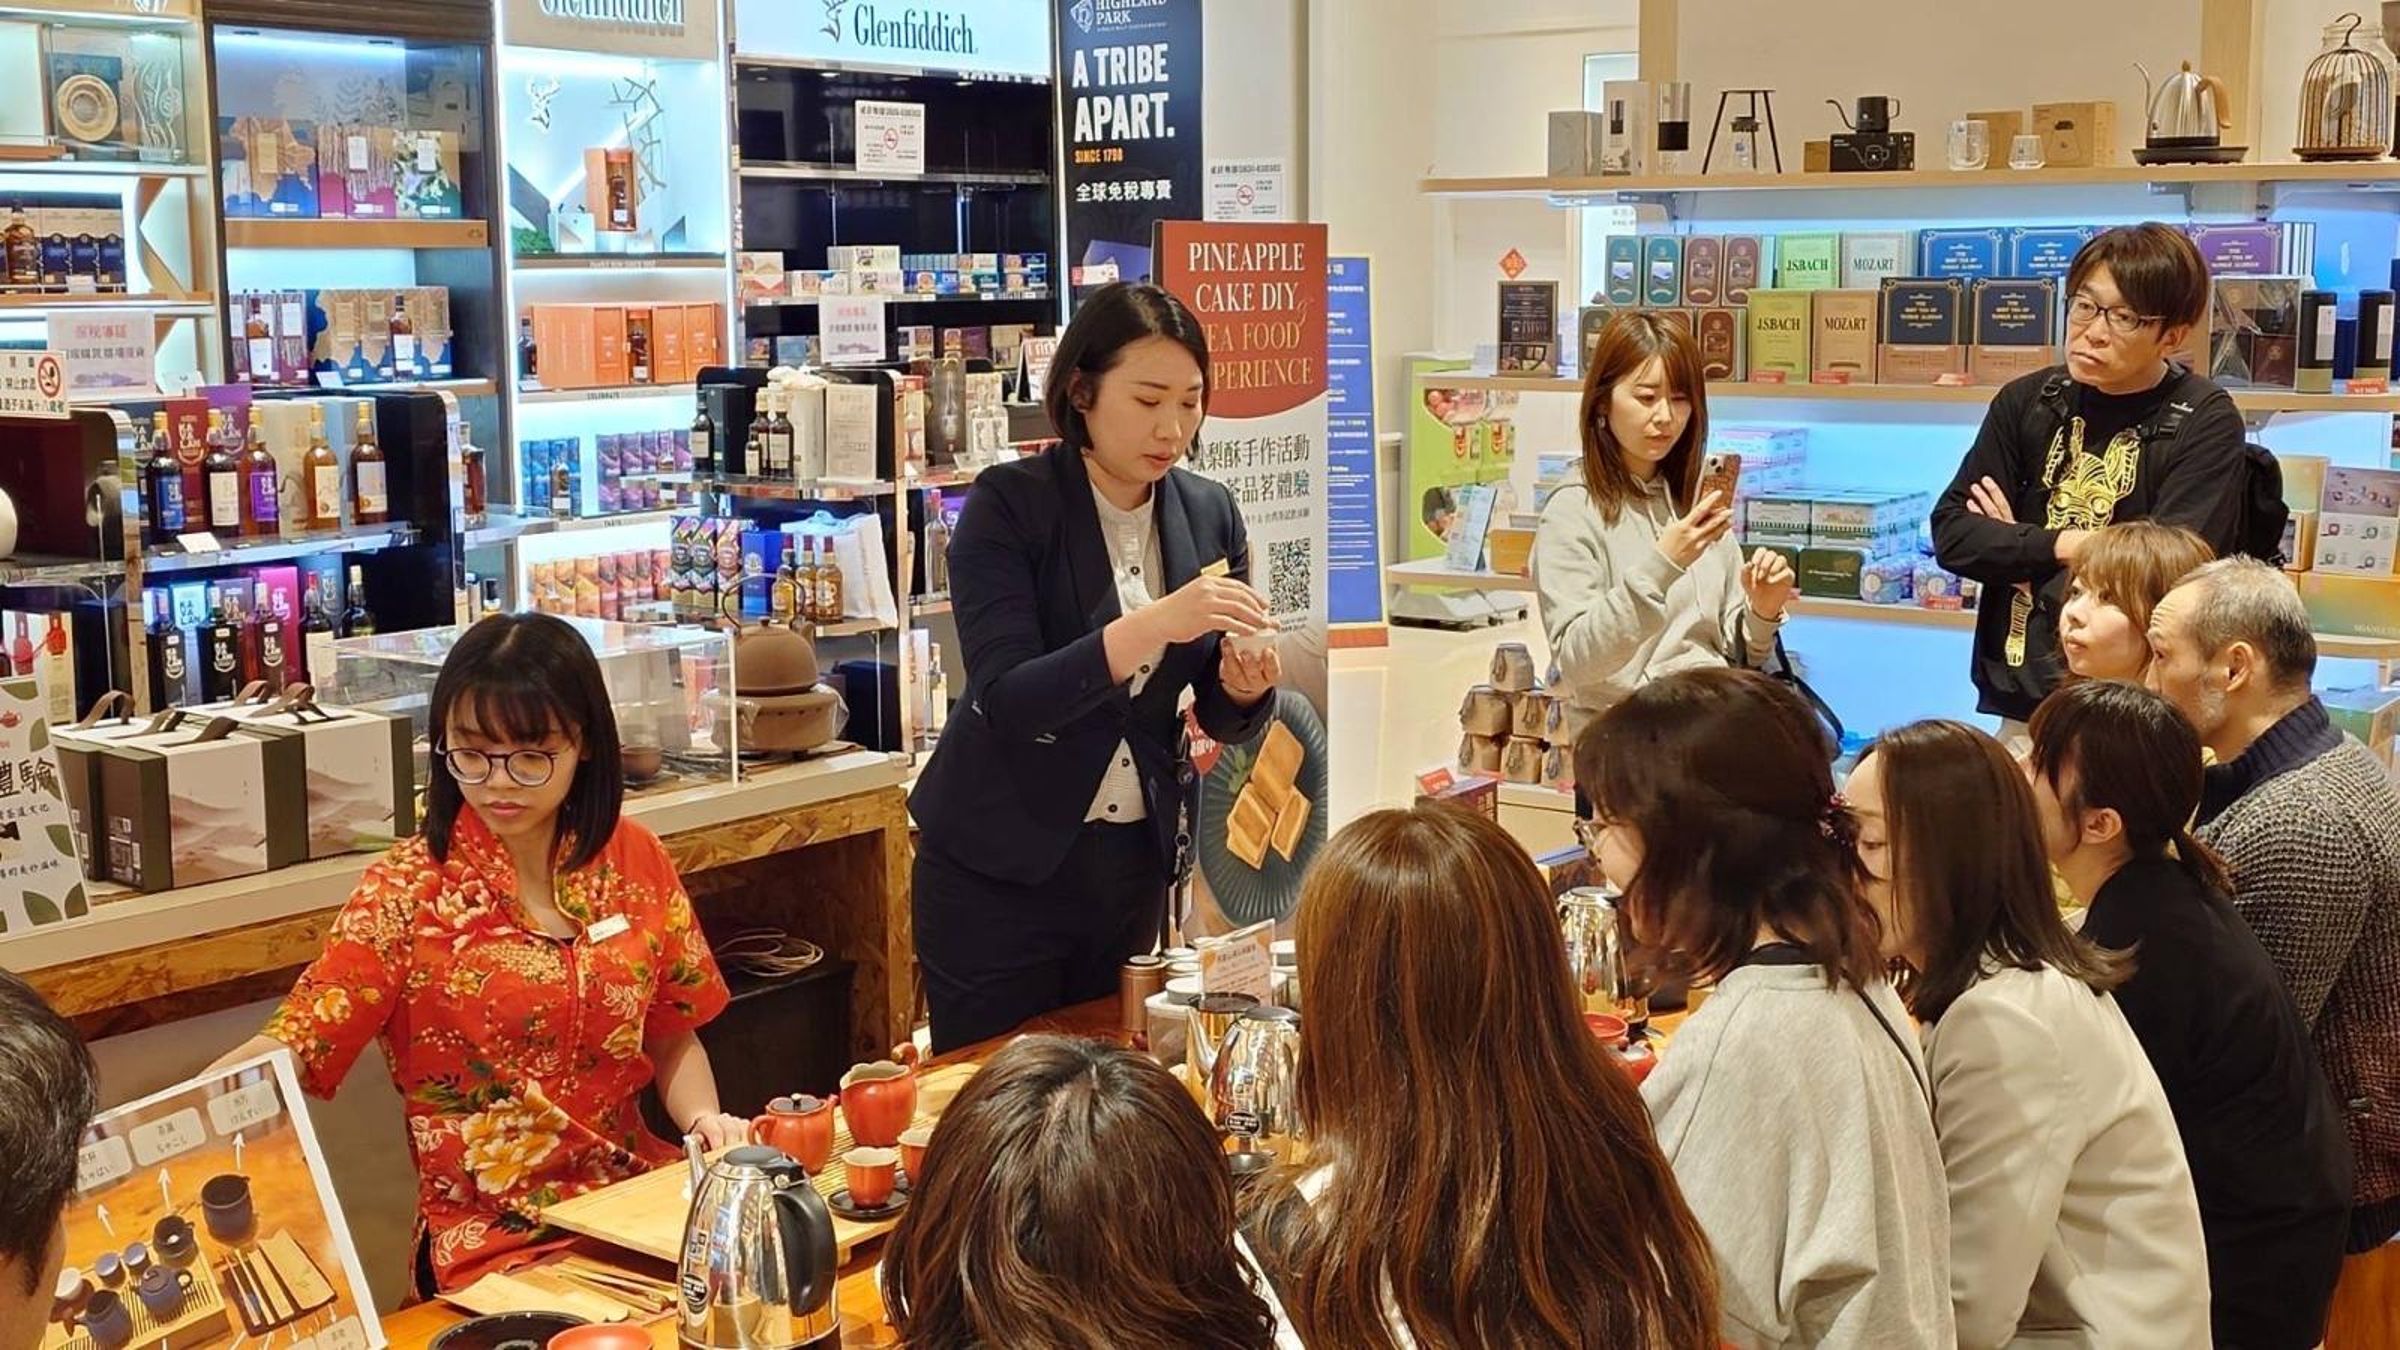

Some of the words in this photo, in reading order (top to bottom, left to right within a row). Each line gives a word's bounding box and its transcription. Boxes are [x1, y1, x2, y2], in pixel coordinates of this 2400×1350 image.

[854, 3, 973, 54] Glenfiddich
[1096, 10, 1131, 24] PARK
[1072, 49, 1089, 88] A
[1093, 43, 1169, 86] TRIBE
[1074, 92, 1175, 142] APART.
[1075, 149, 1101, 163] SINCE
[1188, 242, 1305, 272] PINEAPPLE
[1853, 258, 1894, 271] MOZART
[1195, 282, 1256, 313] CAKE
[1261, 281, 1299, 312] DIY
[1243, 320, 1301, 351] FOOD
[1824, 317, 1868, 331] MOZART
[1213, 357, 1314, 391] PERIENCE
